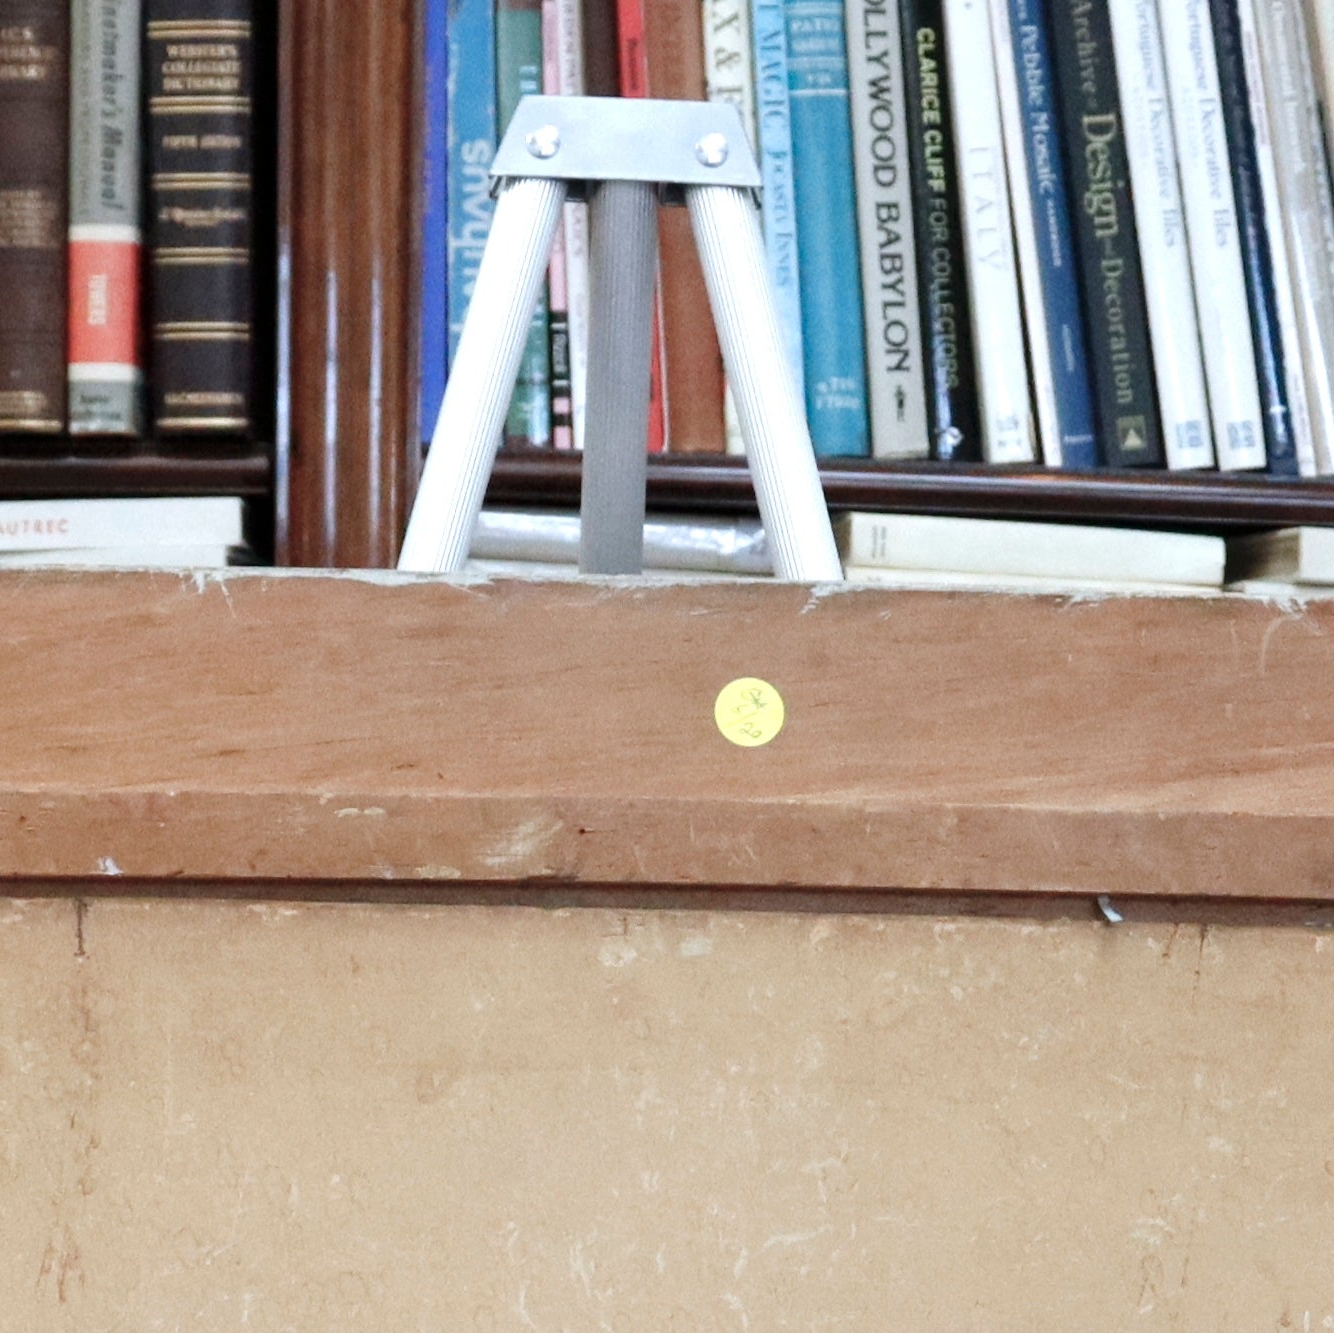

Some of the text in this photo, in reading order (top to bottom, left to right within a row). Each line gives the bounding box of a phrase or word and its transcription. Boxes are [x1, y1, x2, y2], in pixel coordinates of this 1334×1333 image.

[759, 29, 786, 128] MAGIC
[1019, 25, 1047, 105] Pebble
[916, 27, 959, 388] CLARICE CLIFF FOR COLLECTORS
[1030, 111, 1058, 195] Mosaic
[1081, 113, 1125, 238] Design
[876, 201, 912, 372] BABYLON
[1100, 258, 1135, 404] Decoration
